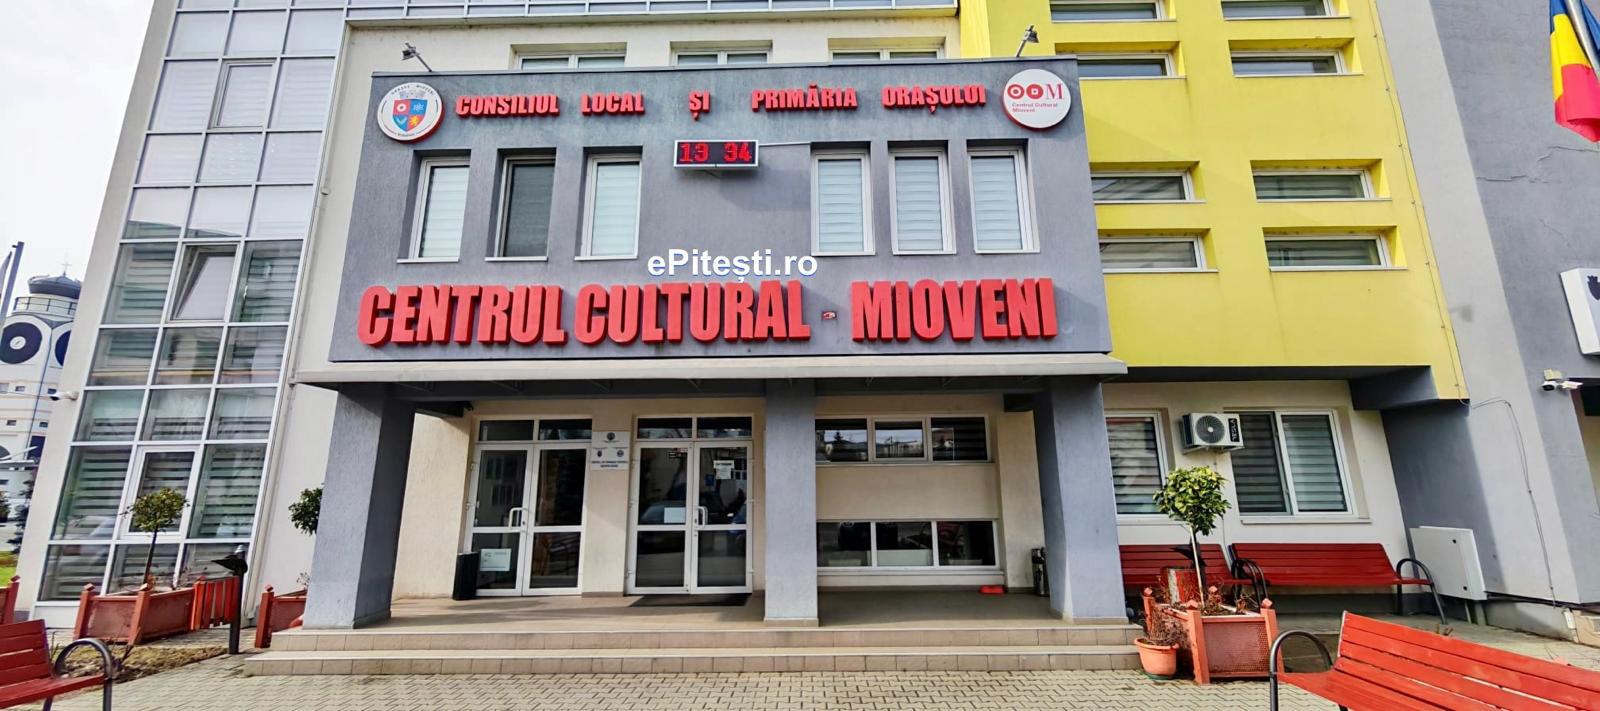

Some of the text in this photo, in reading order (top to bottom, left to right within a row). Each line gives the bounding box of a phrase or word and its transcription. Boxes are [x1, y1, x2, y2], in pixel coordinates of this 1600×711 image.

[455, 93, 560, 119] CONSILIUL
[581, 92, 646, 116] LOCAL
[751, 84, 858, 112] PRIMĂRIA
[357, 284, 567, 346] CENTRUL
[574, 279, 812, 345] CULTURAL
[852, 277, 1058, 342] MIOVENI
